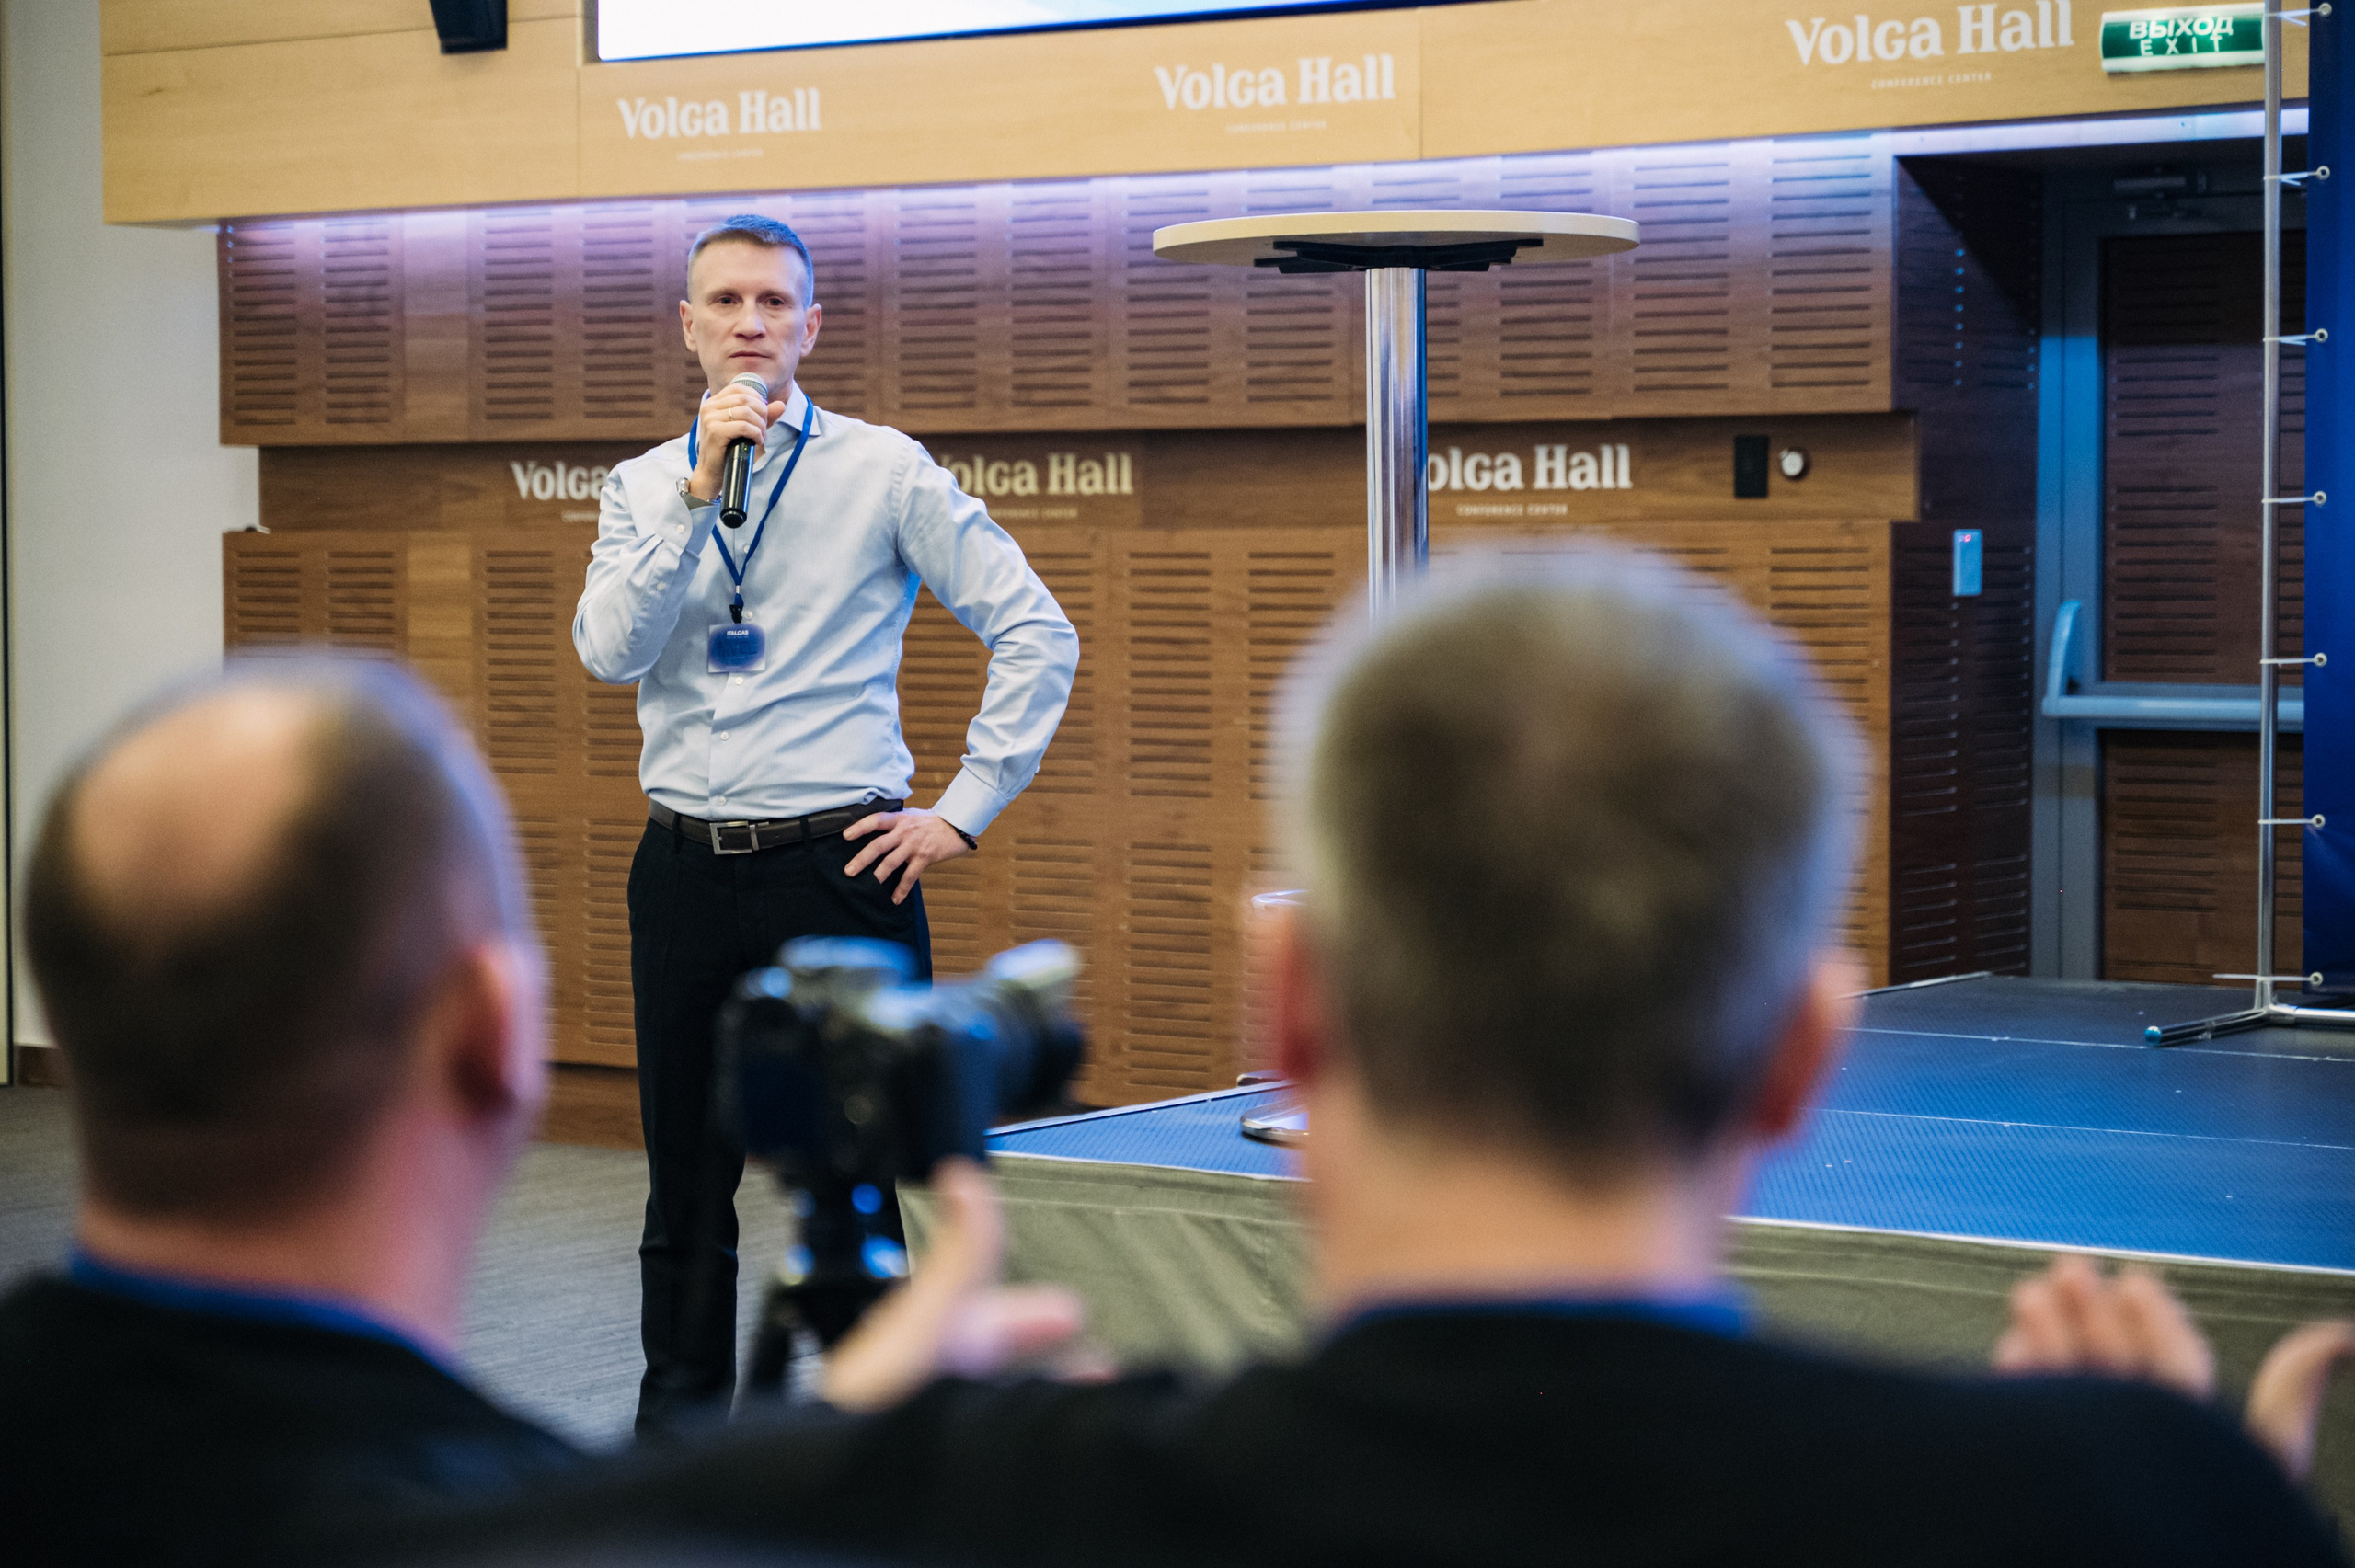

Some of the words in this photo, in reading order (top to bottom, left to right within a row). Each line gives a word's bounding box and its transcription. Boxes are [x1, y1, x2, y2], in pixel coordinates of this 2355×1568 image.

[1785, 14, 1945, 66] Volga
[1956, 0, 2074, 54] Hall
[2129, 16, 2234, 40] ВЫХОД
[2140, 35, 2223, 57] EXIT
[1154, 62, 1287, 110] Volga
[1296, 52, 1396, 104] Hall
[616, 95, 730, 139] Volga
[738, 86, 822, 134] Hall
[940, 453, 1040, 497] olga
[1047, 452, 1134, 496] Hall
[1428, 446, 1525, 492] olga
[1533, 443, 1633, 490] Hall
